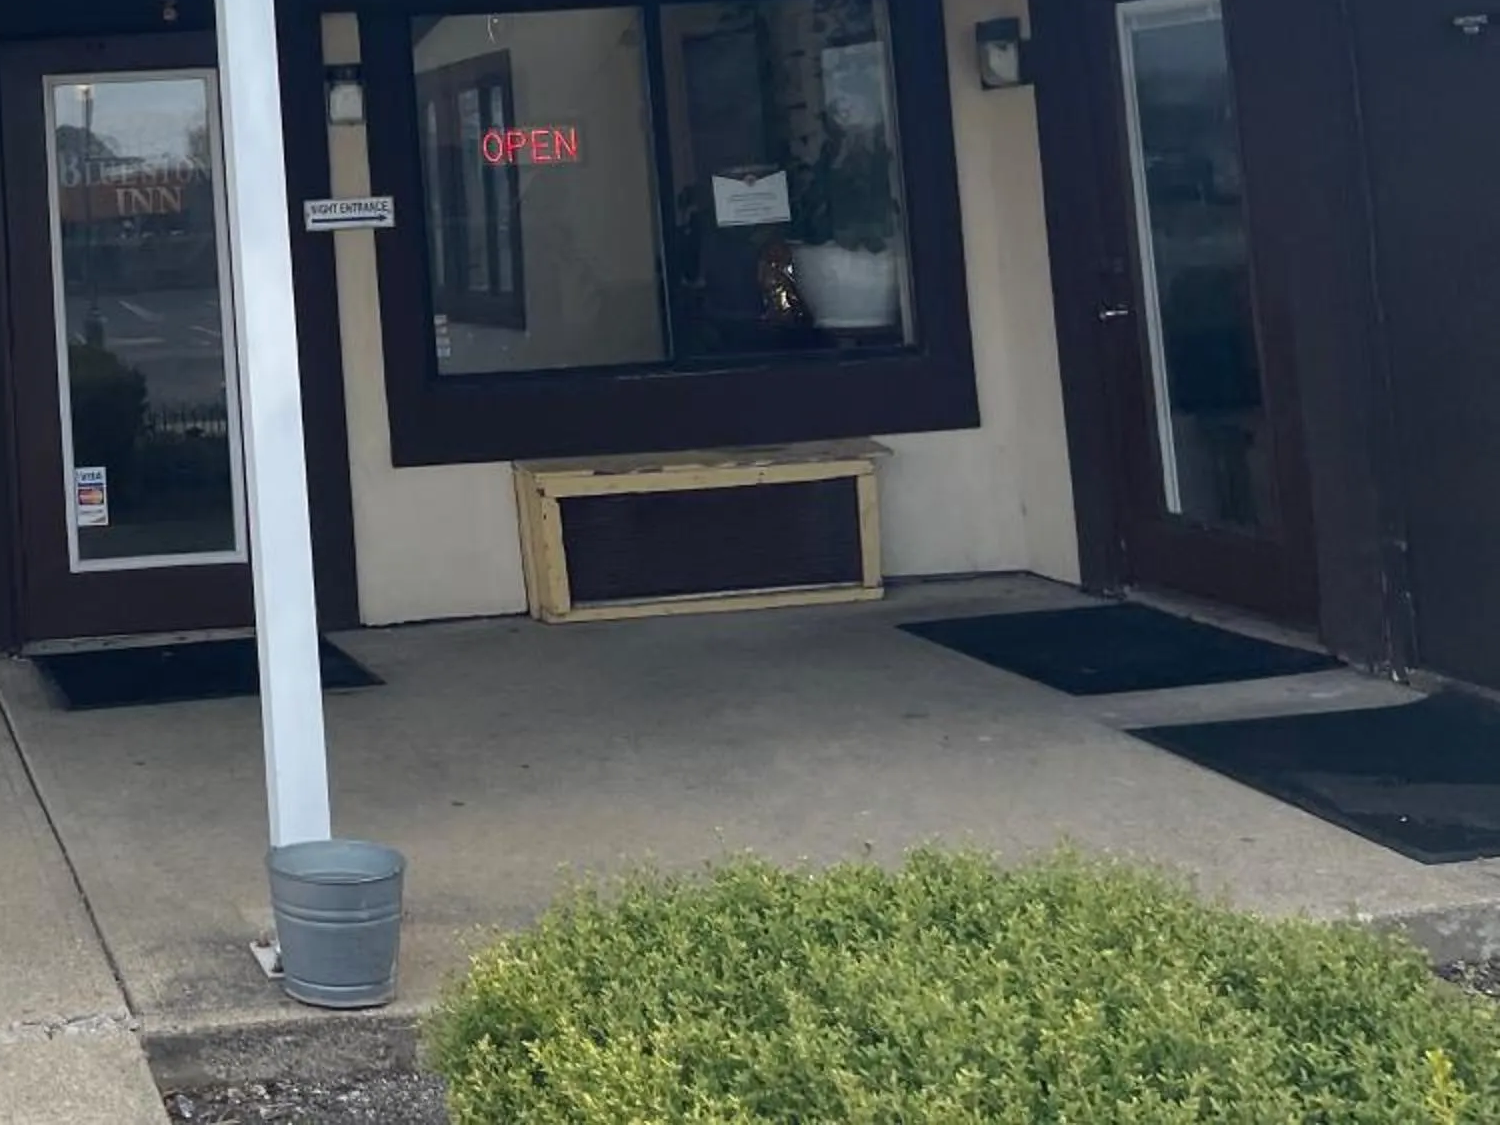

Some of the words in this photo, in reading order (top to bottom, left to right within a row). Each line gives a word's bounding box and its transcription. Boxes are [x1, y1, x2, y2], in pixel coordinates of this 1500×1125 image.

[483, 126, 578, 163] OPEN
[116, 186, 182, 216] INN
[339, 200, 389, 214] ENTRANCE
